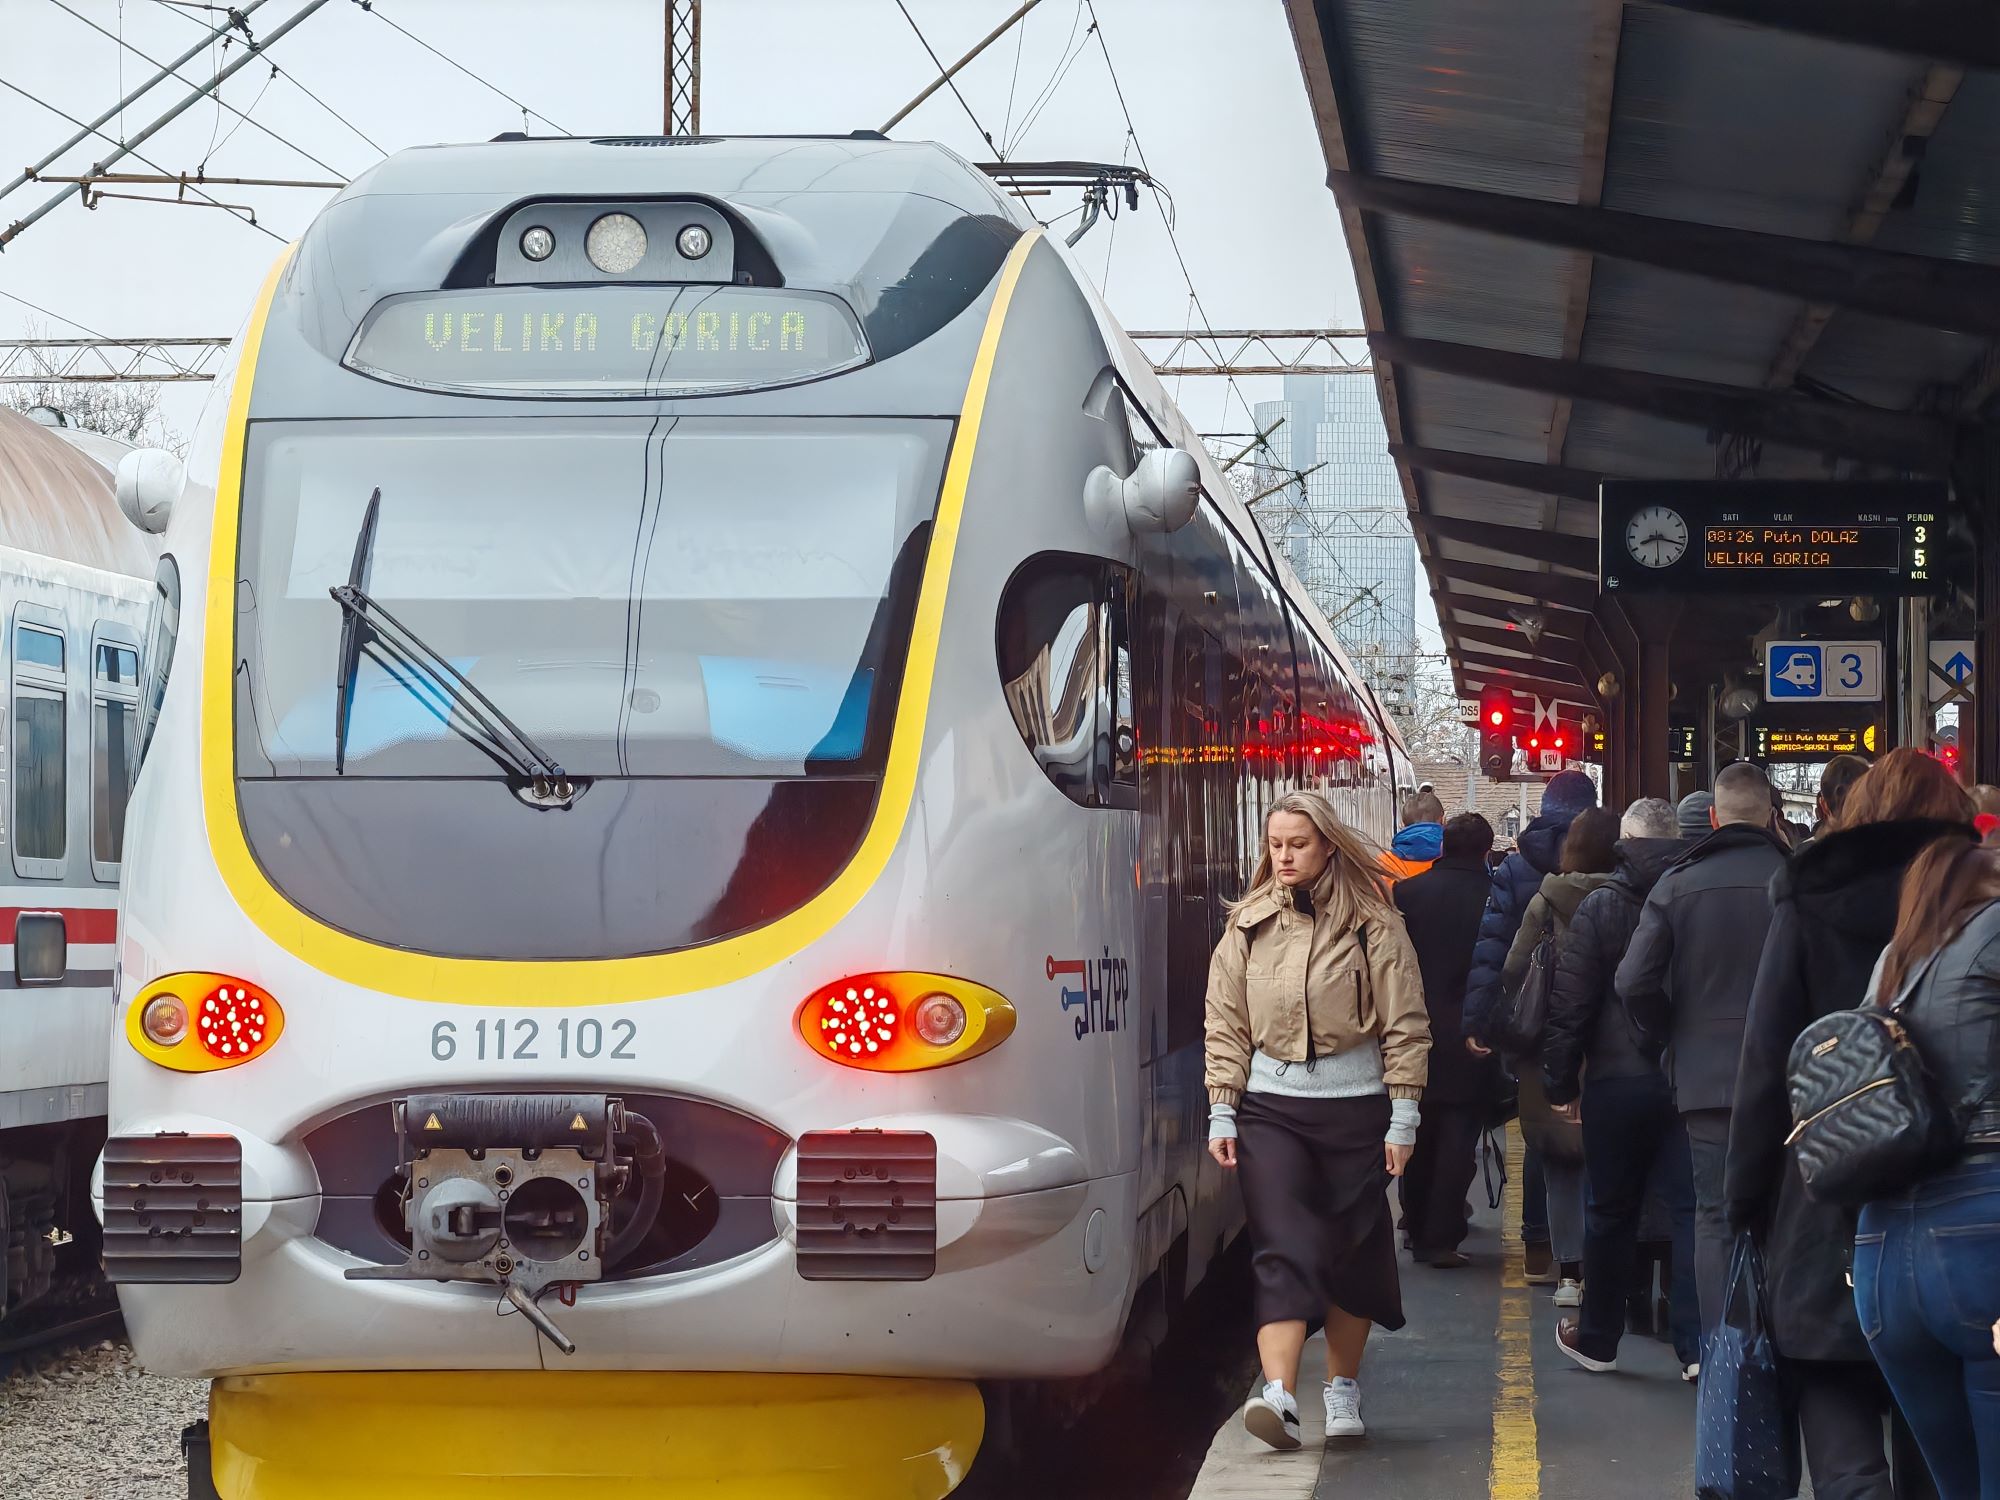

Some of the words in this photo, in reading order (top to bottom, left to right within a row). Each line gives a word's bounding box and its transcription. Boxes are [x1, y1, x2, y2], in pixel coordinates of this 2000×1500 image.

[424, 311, 598, 352] VELIKA
[631, 311, 807, 352] GORICA
[1722, 513, 1739, 521] SATI
[1773, 514, 1793, 522] VLAK
[1857, 513, 1880, 522] KASNI
[1907, 513, 1934, 522] PERON
[1707, 531, 1754, 543] 08:26
[1764, 530, 1801, 543] Putn
[1811, 530, 1859, 543] DOLAZ
[1914, 526, 1926, 543] 3
[1707, 552, 1763, 565] VELIKA
[1773, 552, 1830, 565] GORICA
[1840, 653, 1864, 689] 3
[1461, 705, 1479, 716] DS5
[1685, 732, 1692, 741] 3
[1758, 732, 1765, 741] 3
[1088, 944, 1129, 1033] HŽPP
[431, 1020, 457, 1061] 6
[475, 1018, 540, 1060] 112
[557, 1017, 637, 1060] 102
